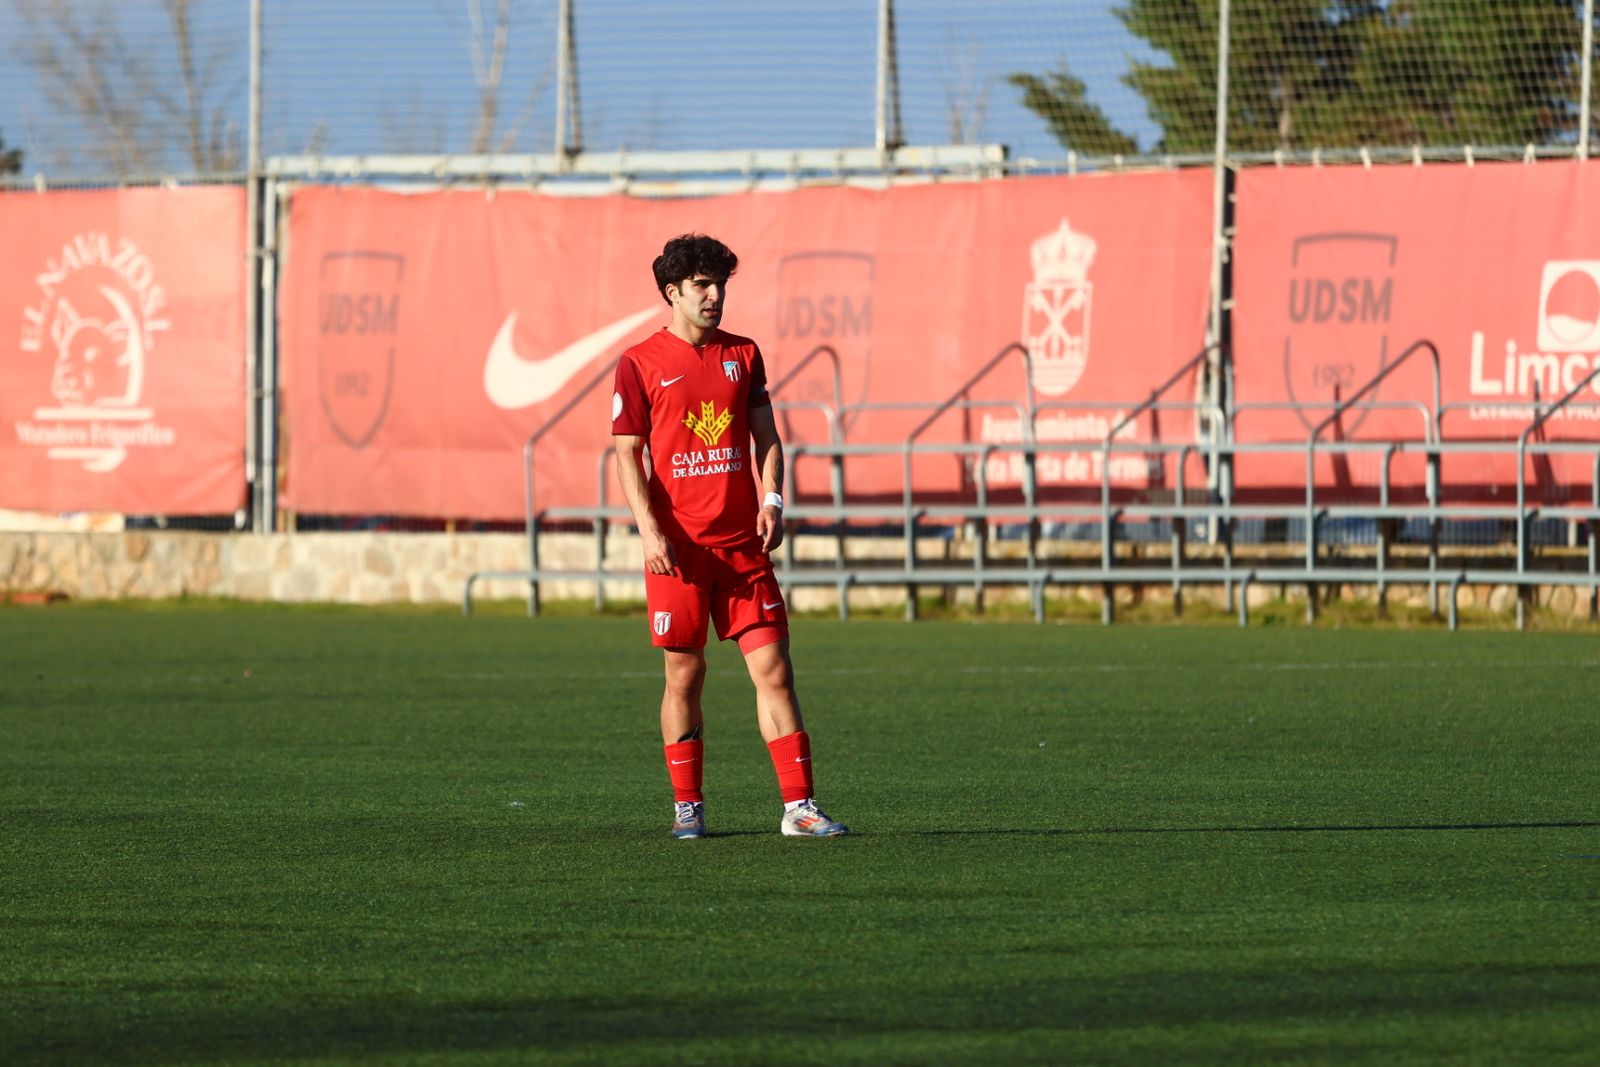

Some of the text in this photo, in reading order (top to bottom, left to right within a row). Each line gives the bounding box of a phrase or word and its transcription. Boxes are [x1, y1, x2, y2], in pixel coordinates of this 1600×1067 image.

[319, 292, 400, 335] UDSM
[775, 294, 873, 338] UDSM
[1288, 276, 1393, 324] UDSM
[672, 450, 705, 467] CAJA
[673, 468, 687, 478] DE
